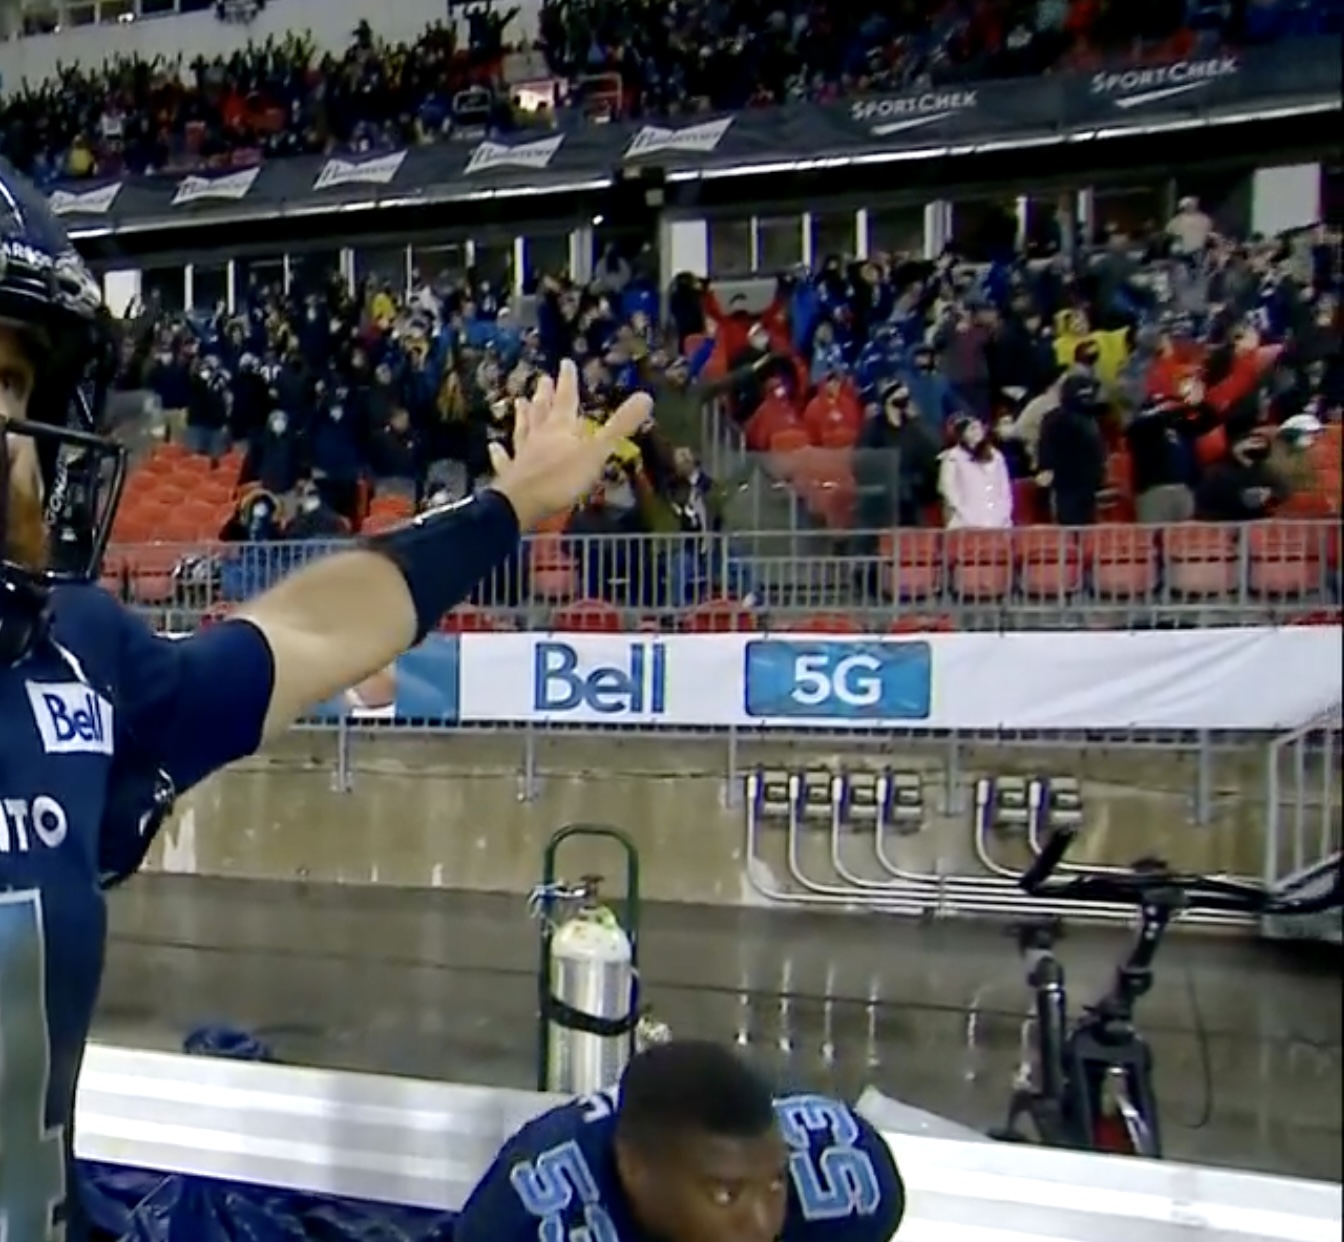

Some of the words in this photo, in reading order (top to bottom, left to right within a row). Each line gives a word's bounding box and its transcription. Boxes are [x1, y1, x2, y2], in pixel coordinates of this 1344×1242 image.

[532, 641, 666, 714] Bell
[790, 655, 884, 706] 5G
[41, 692, 104, 743] Bell
